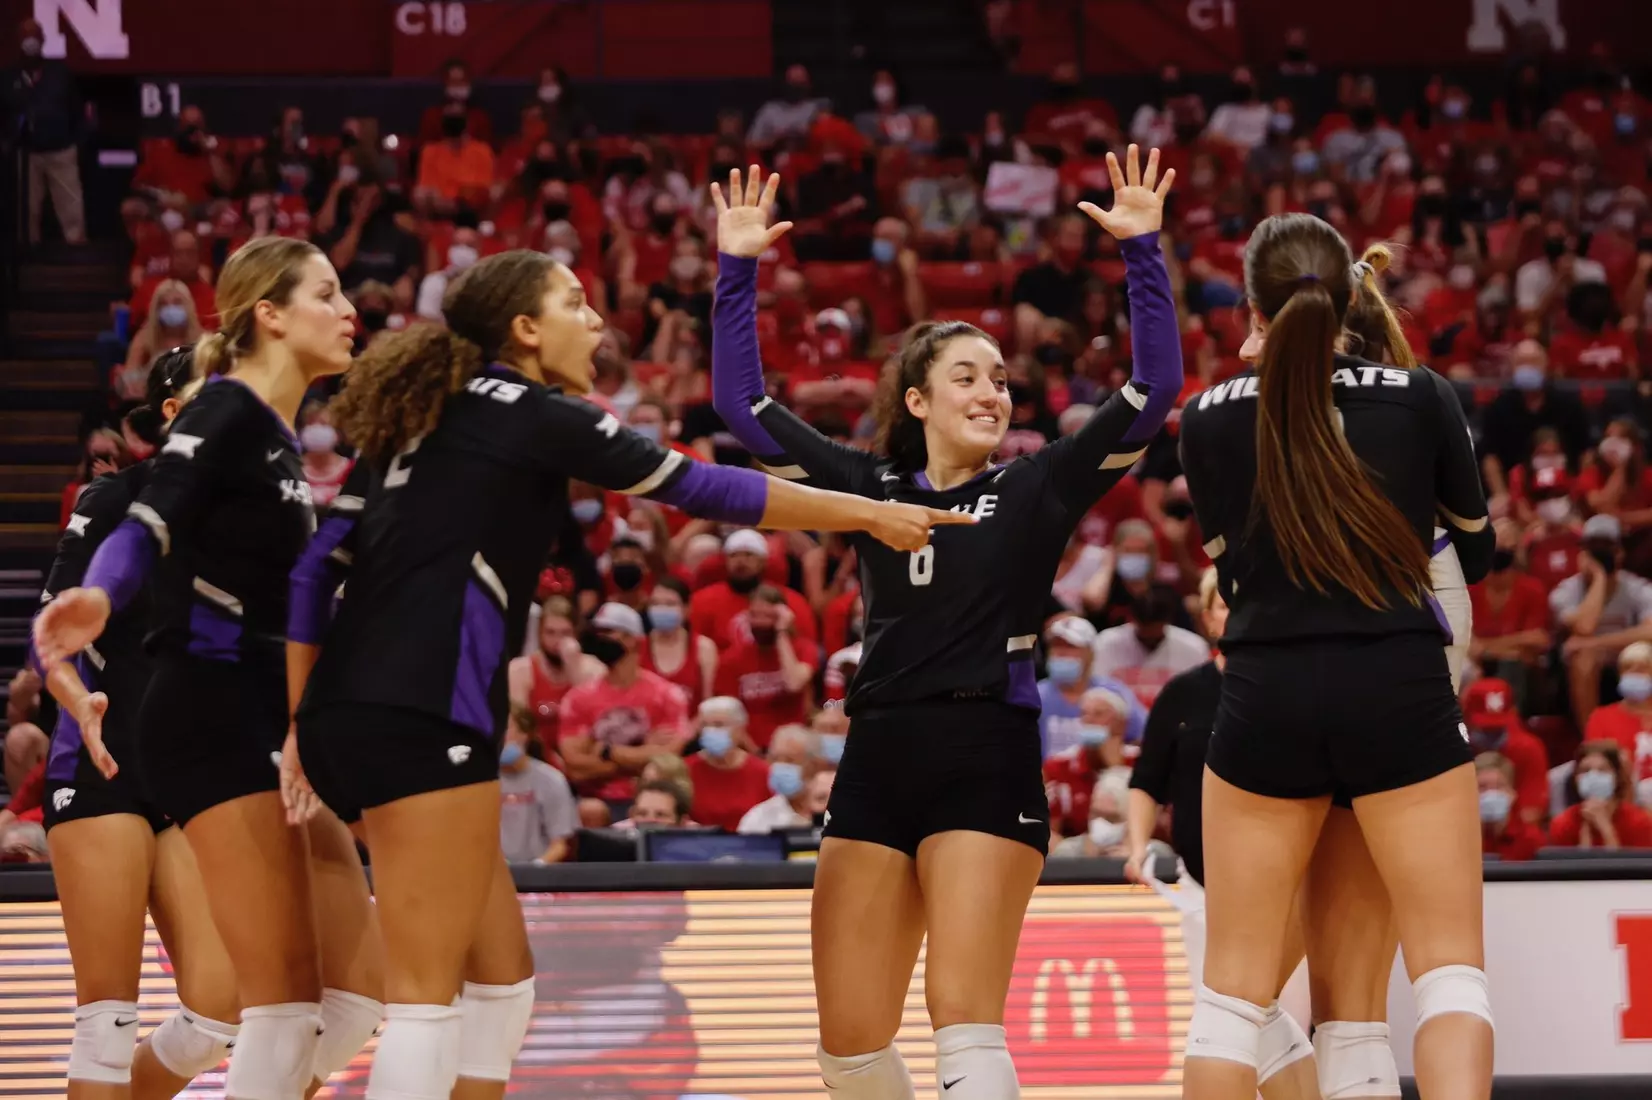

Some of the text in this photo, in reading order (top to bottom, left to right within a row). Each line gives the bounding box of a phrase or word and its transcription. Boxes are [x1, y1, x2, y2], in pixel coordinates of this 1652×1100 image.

[396, 1, 467, 36] C18
[1187, 0, 1235, 30] C1
[1198, 366, 1411, 411] WILATS
